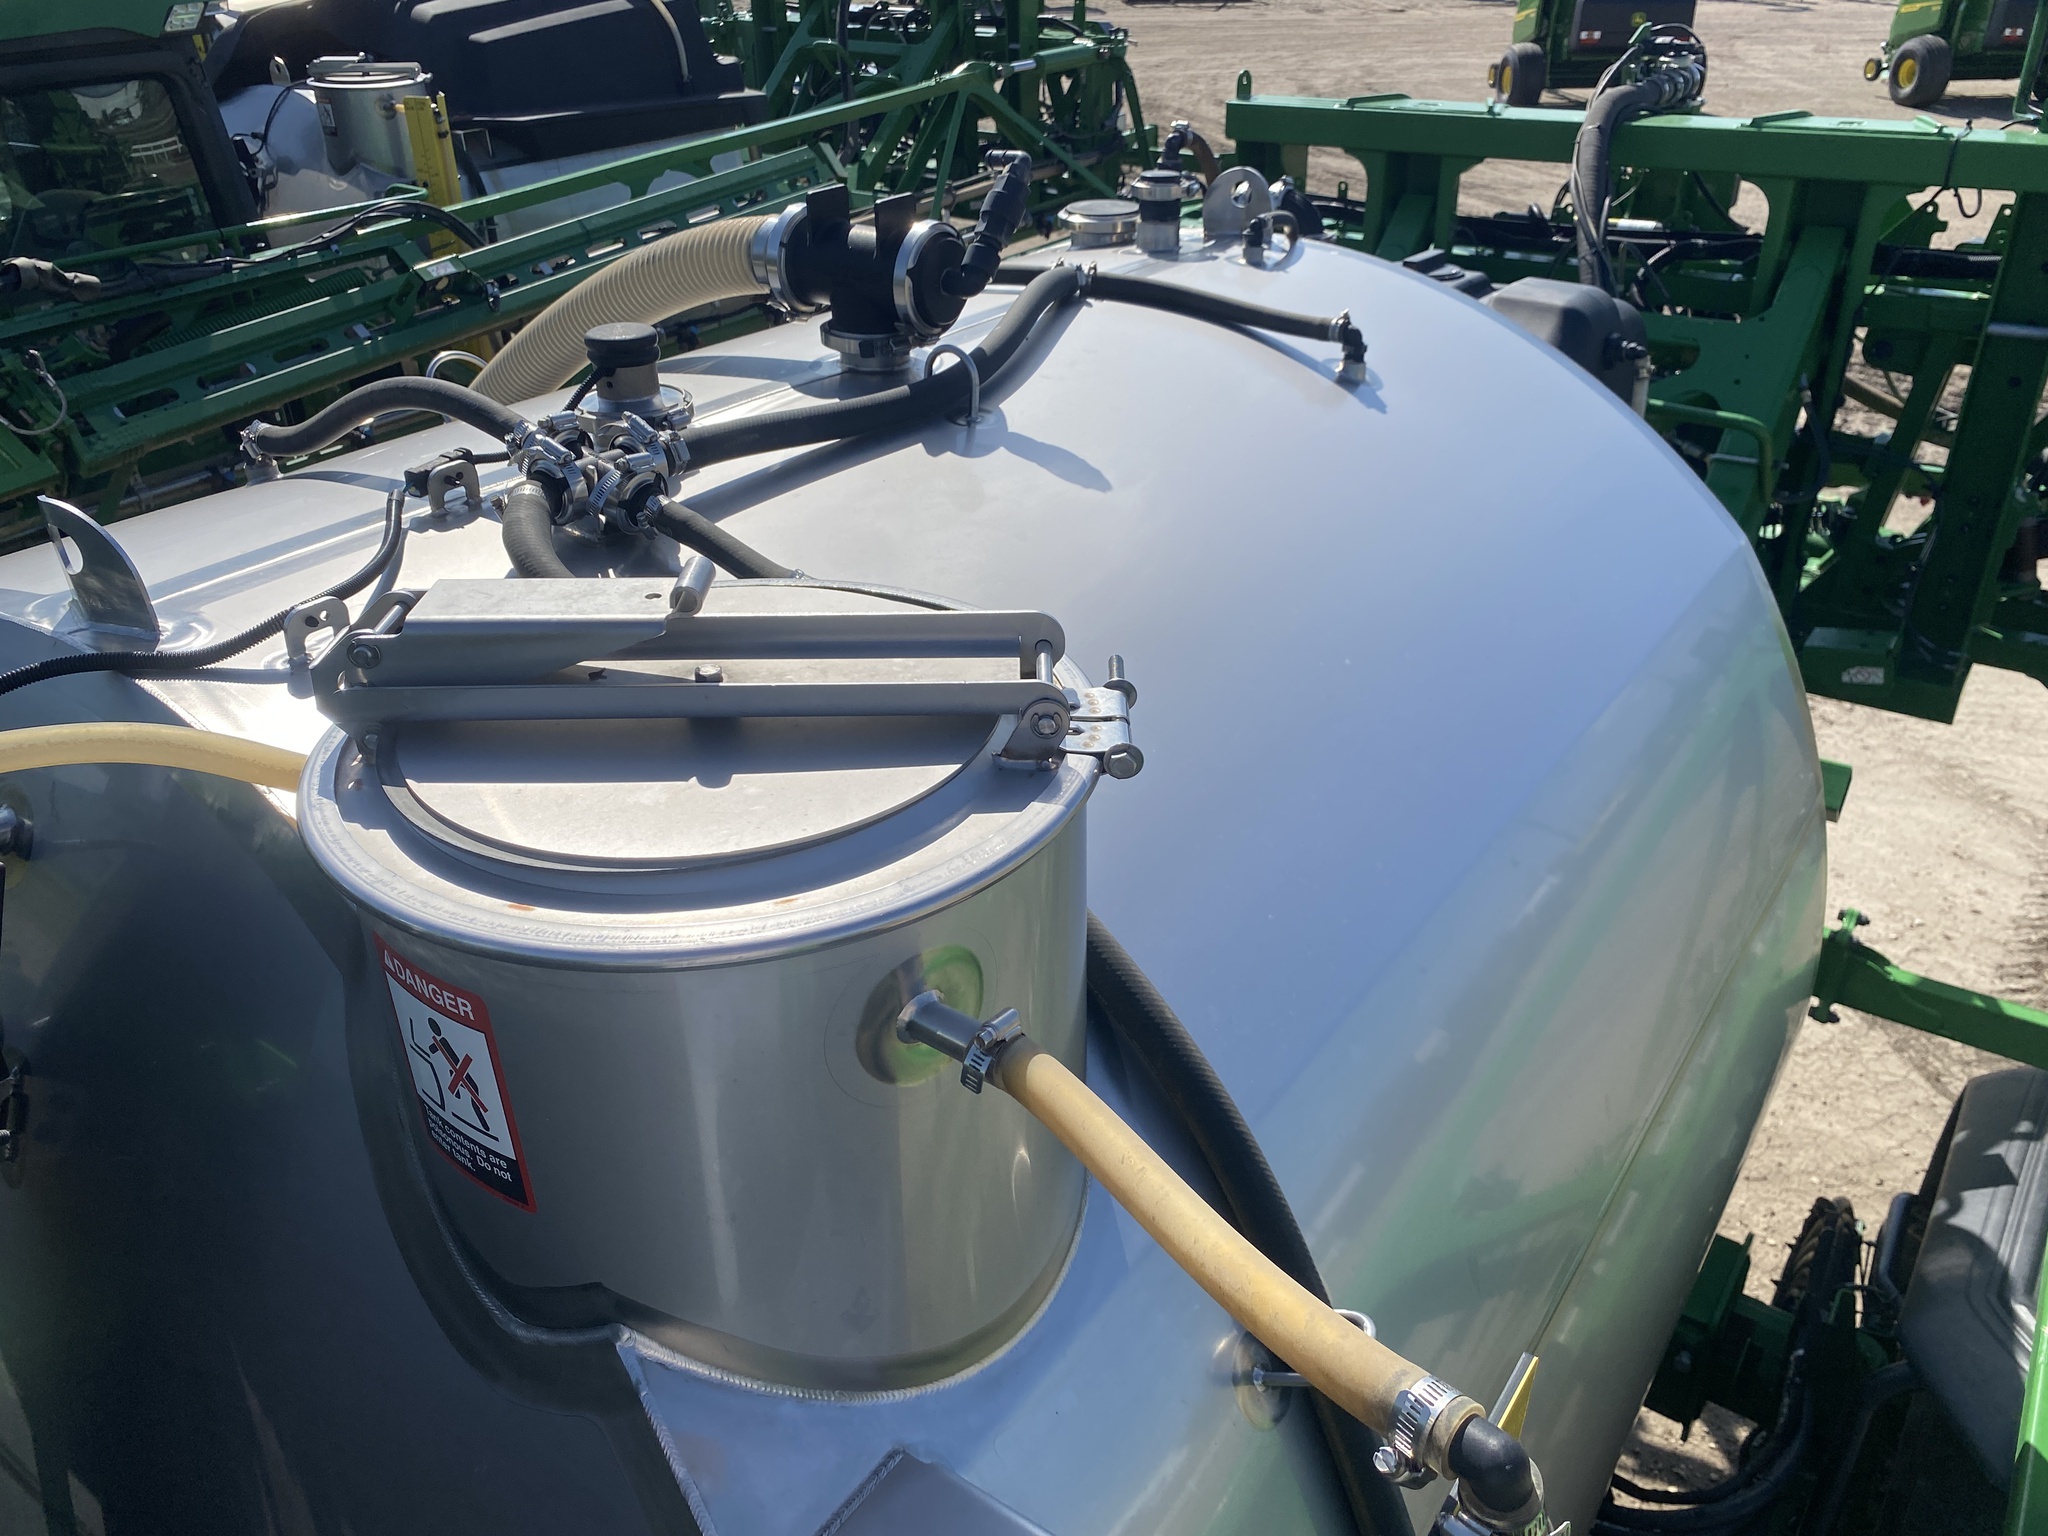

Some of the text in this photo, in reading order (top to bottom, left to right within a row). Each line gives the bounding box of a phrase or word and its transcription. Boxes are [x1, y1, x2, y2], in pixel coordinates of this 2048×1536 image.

[393, 957, 475, 1021] DANGER
[424, 1103, 508, 1169] Tank contents are
[452, 1148, 476, 1172] tank.
[476, 1155, 492, 1171] Do
[494, 1166, 513, 1183] not
